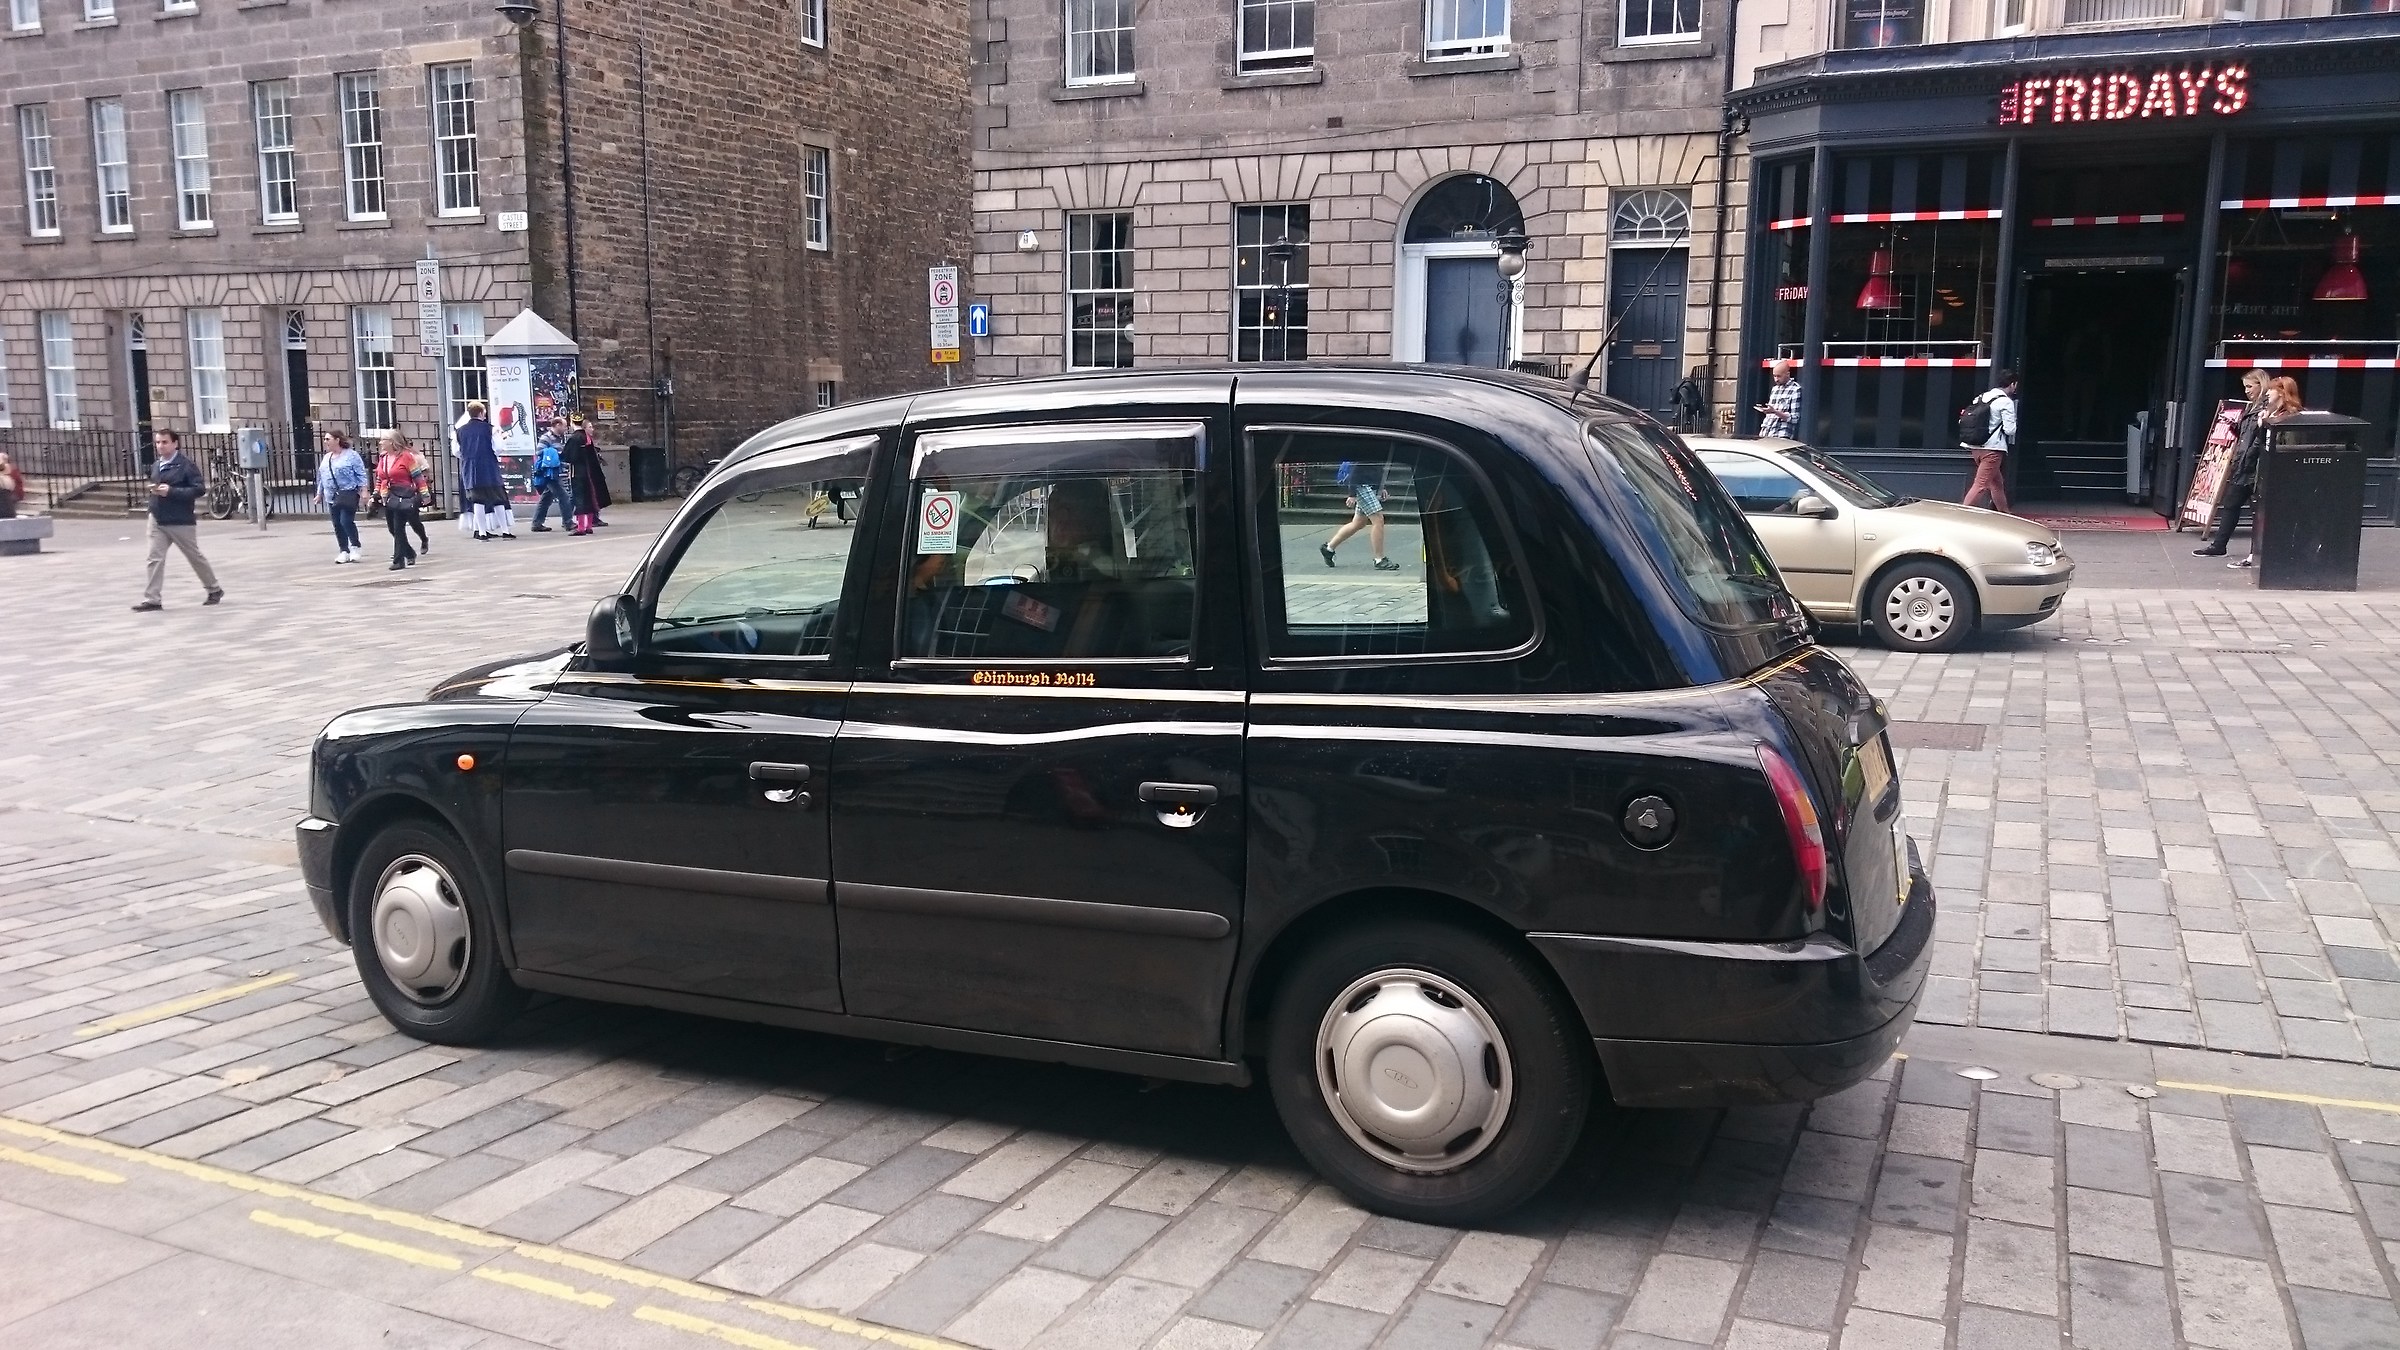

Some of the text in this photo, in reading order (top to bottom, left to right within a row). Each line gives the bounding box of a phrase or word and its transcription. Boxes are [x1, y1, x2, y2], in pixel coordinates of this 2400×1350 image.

[501, 213, 523, 221] CASTLE
[503, 221, 523, 229] STREET
[1463, 224, 1473, 233] 22
[1645, 286, 1654, 294] 24
[973, 671, 1050, 686] Edinburgh
